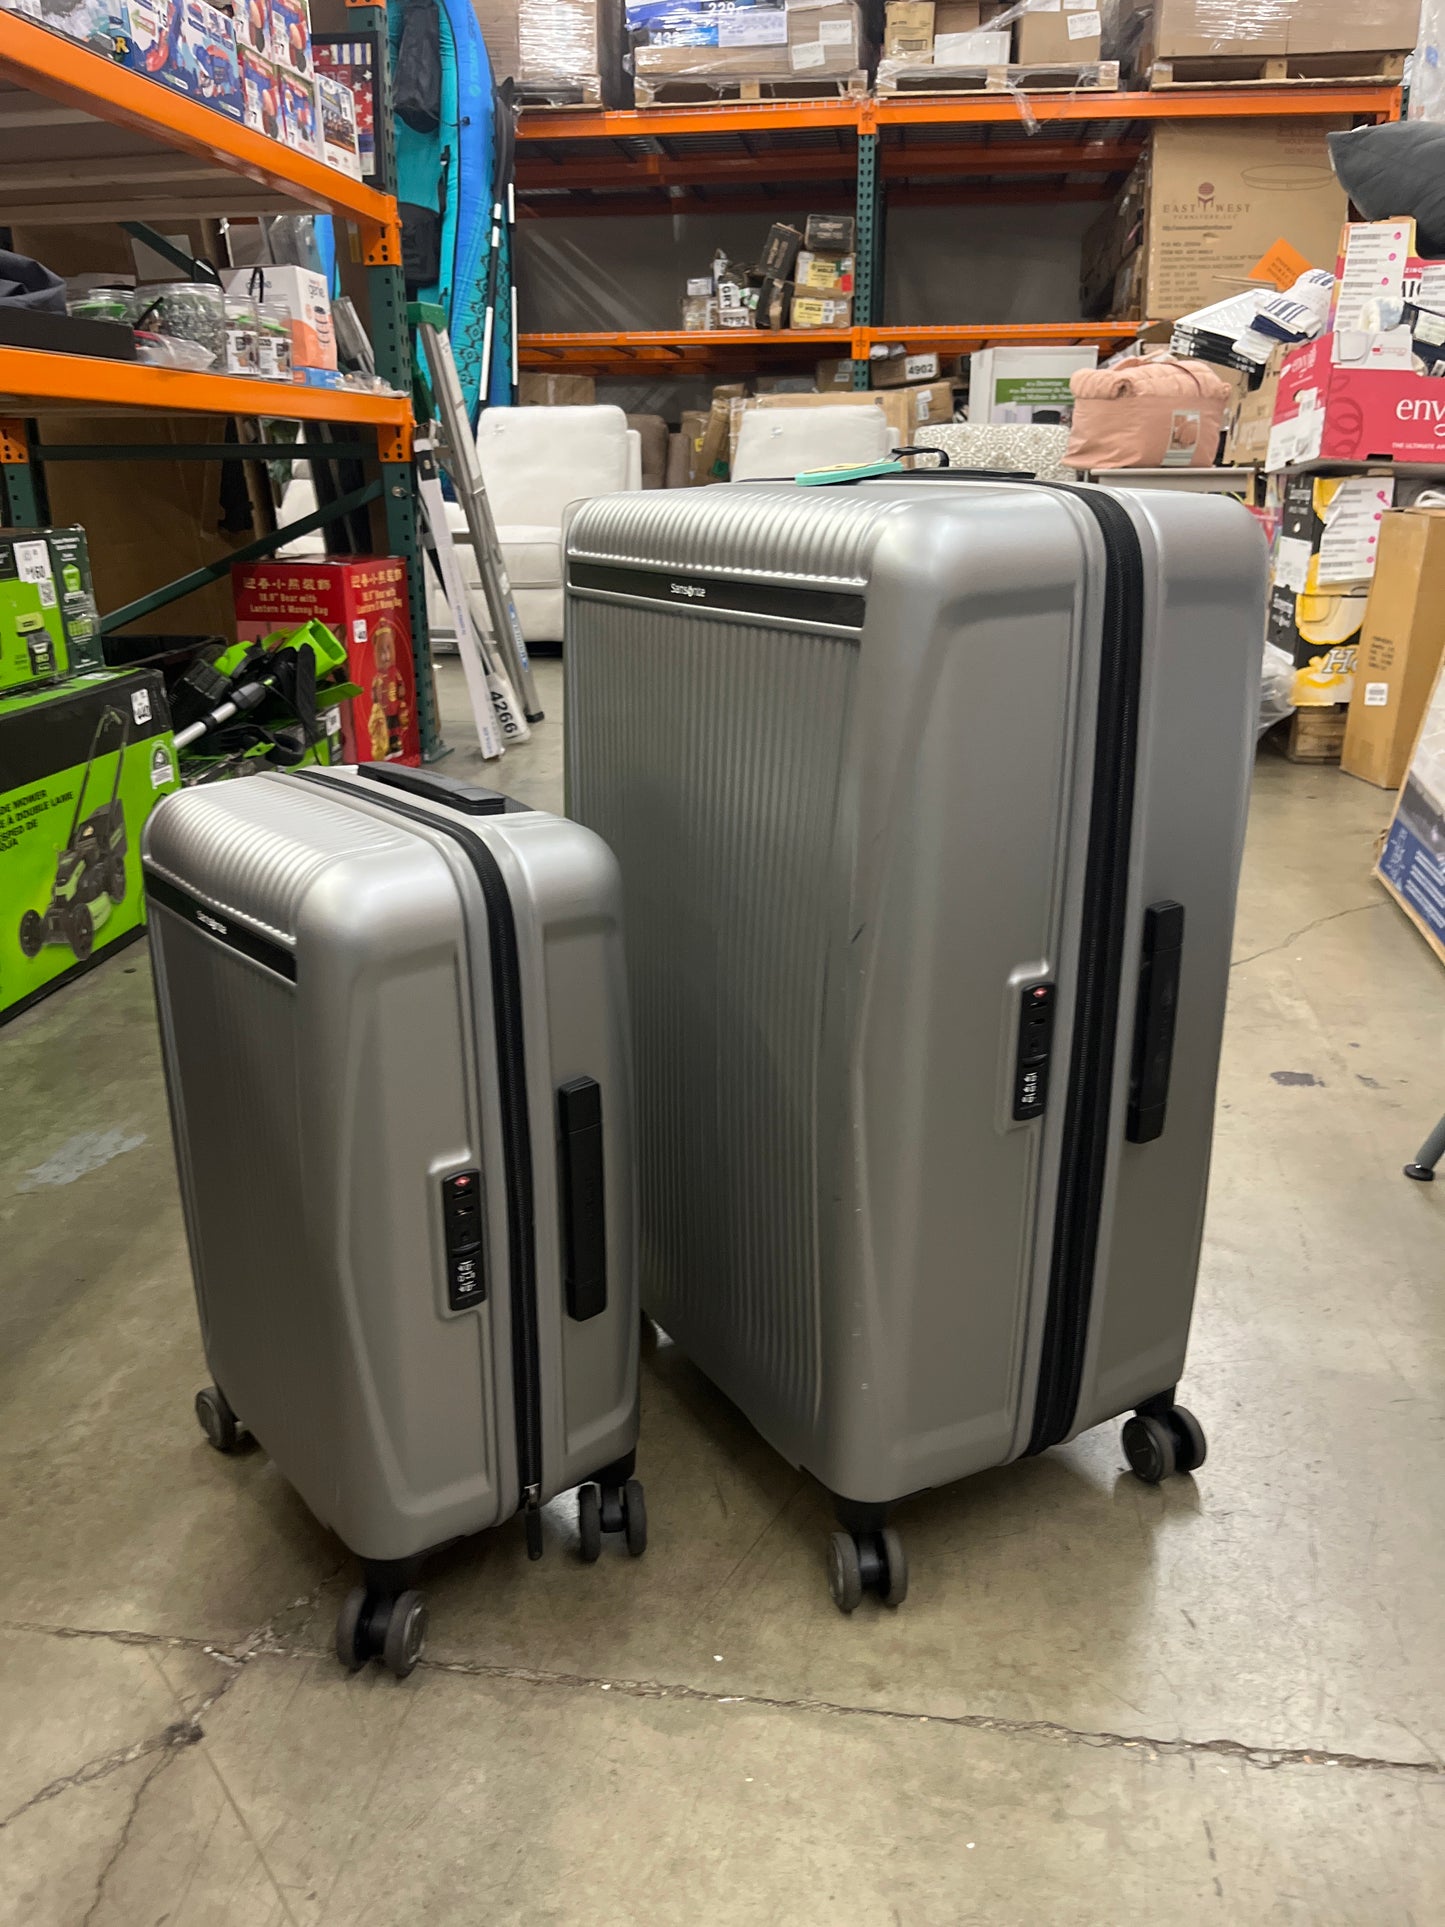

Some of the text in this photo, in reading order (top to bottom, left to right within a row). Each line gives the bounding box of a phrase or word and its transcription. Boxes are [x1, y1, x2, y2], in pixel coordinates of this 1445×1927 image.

[1163, 204, 1250, 213] EAST WEST
[908, 364, 934, 375] 4902
[1396, 399, 1445, 437] env
[489, 690, 519, 734] 4266
[13, 789, 48, 809] MOWER
[15, 801, 50, 822] DOUBLE
[51, 791, 74, 807] LAME
[26, 819, 38, 831] DE
